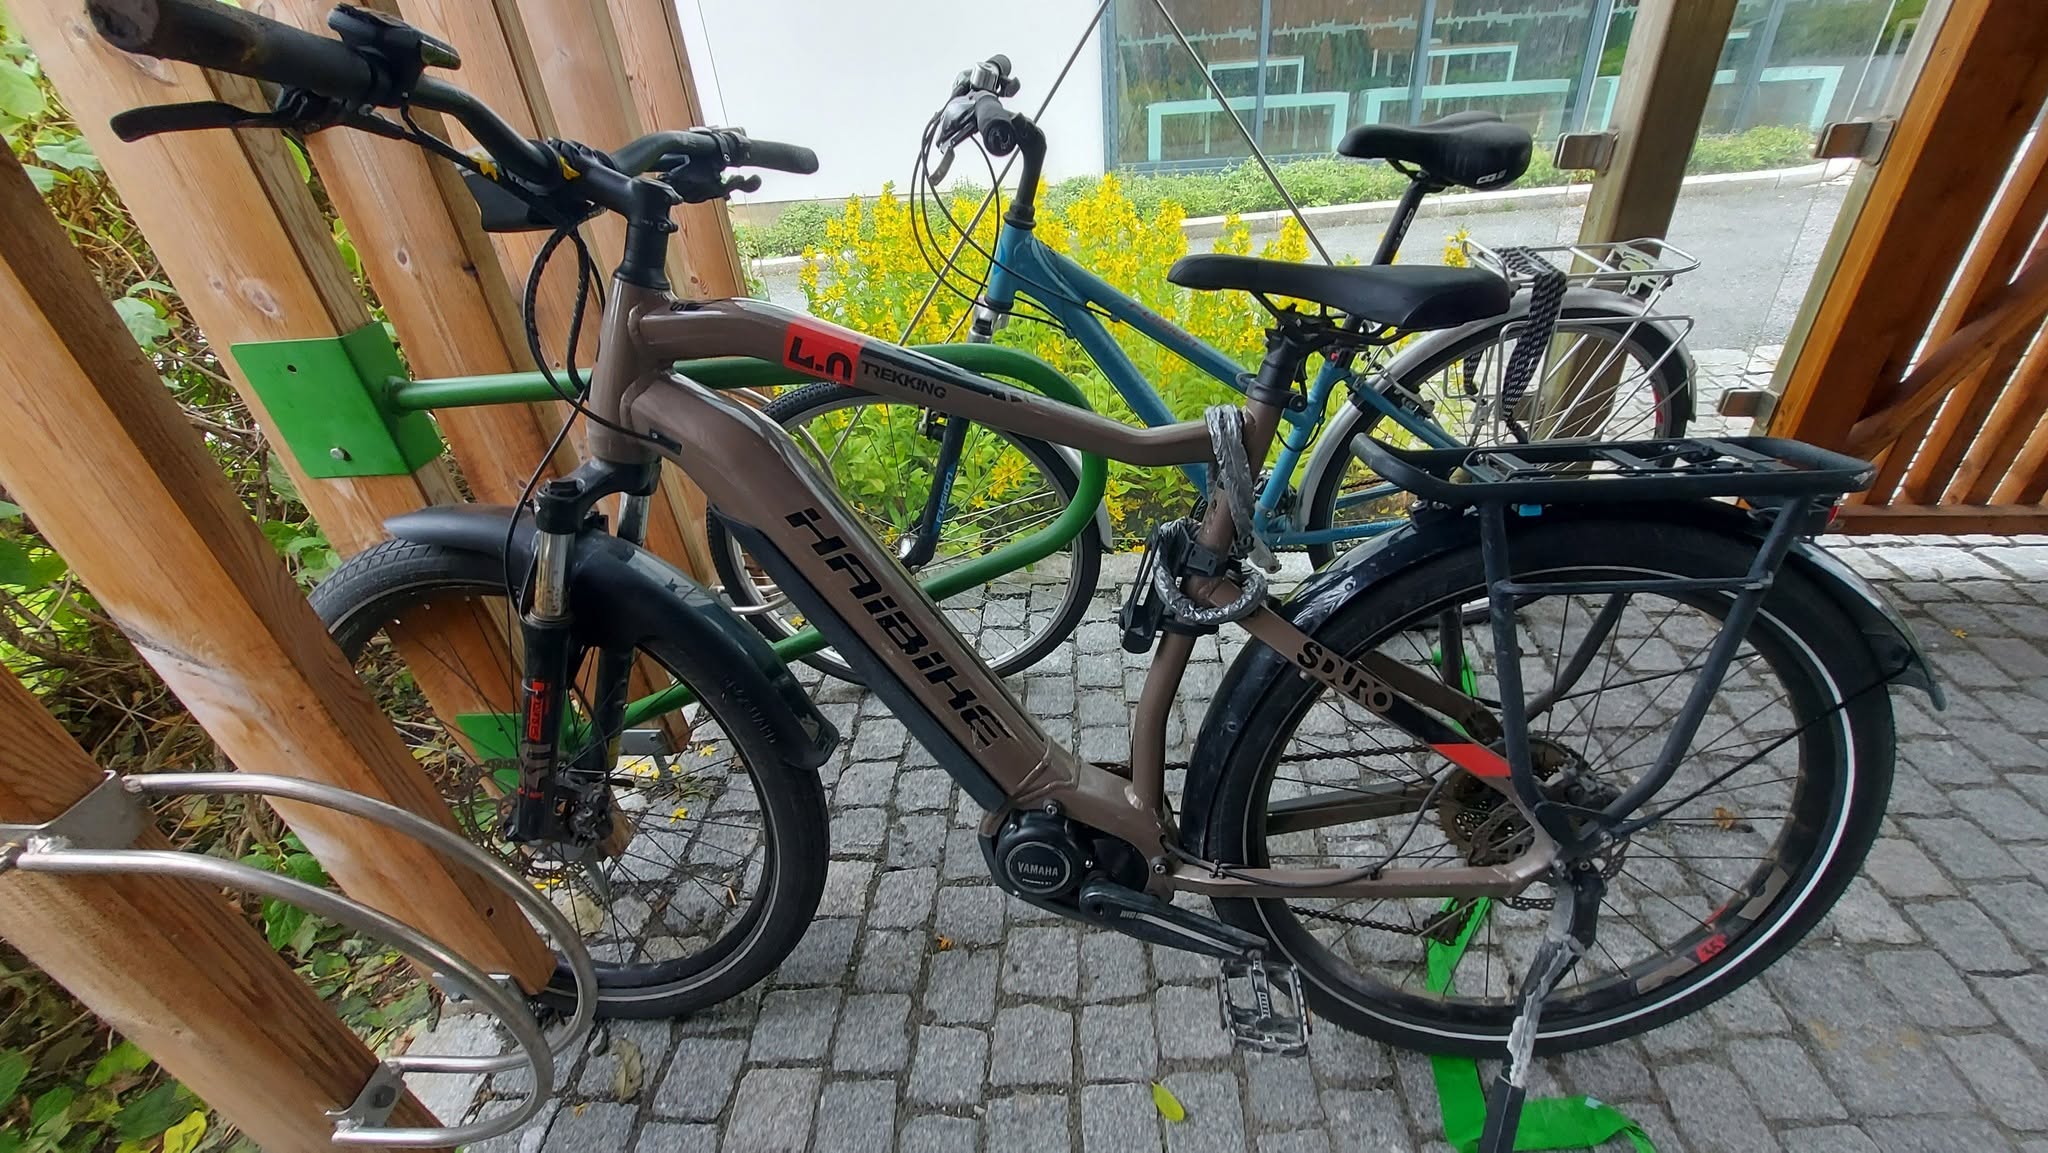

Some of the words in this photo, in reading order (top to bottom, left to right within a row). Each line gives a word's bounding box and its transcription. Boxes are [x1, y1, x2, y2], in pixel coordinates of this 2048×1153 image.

[861, 359, 948, 399] TREKKING
[784, 507, 1013, 748] HAIBIKE
[1297, 641, 1394, 713] SDURO
[1017, 861, 1059, 876] YAMAHA
